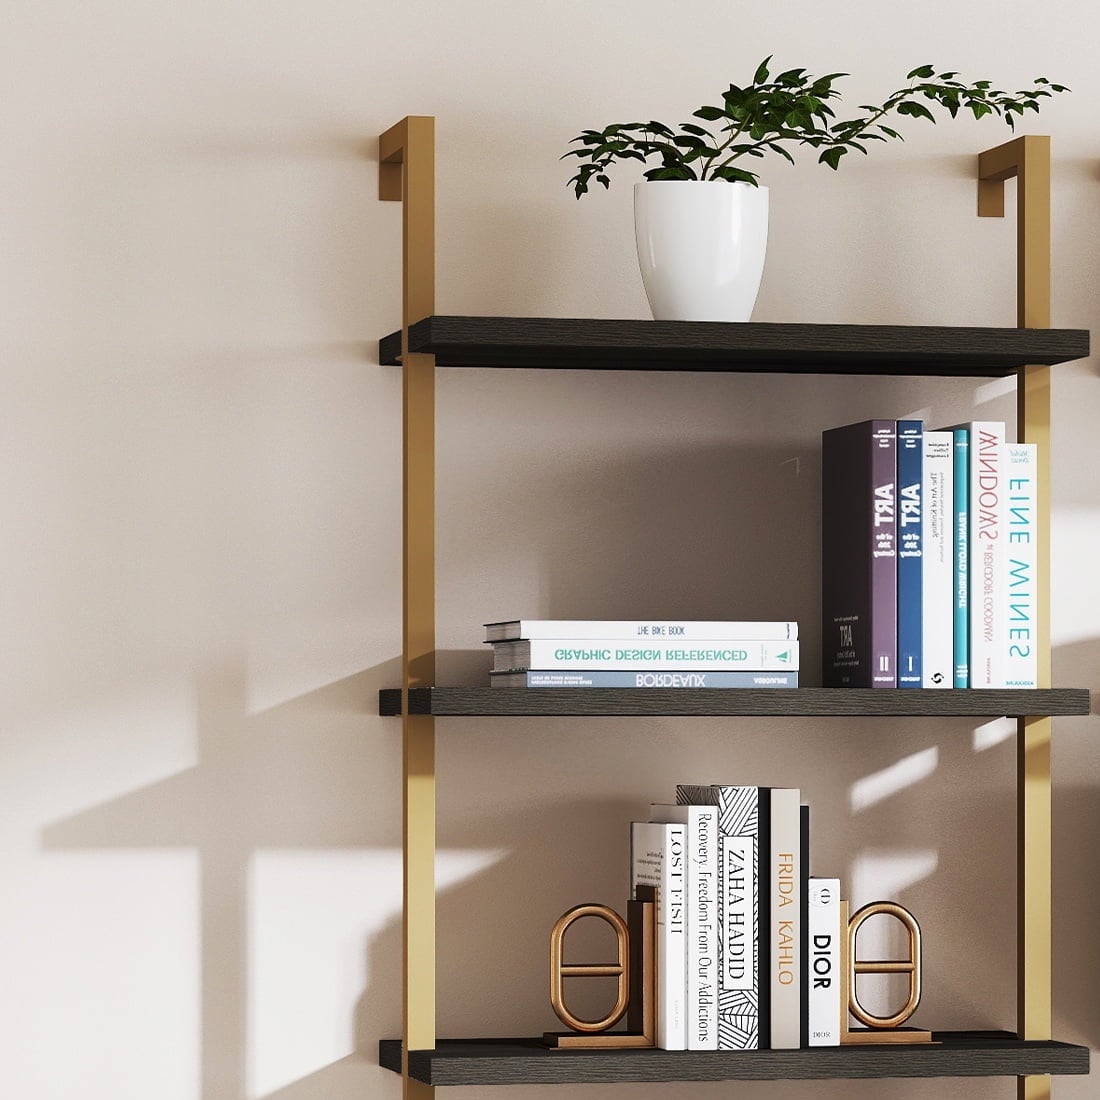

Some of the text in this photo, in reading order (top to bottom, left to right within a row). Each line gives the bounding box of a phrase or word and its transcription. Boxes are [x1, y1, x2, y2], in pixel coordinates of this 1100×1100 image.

[671, 830, 682, 934] LOST FISH
[693, 814, 712, 1042] Recovery. Freedom From Our Addictions
[729, 850, 744, 980] ZAHA HADID
[778, 853, 793, 985] FRIDA KAHLO
[813, 934, 831, 989] DIOR
